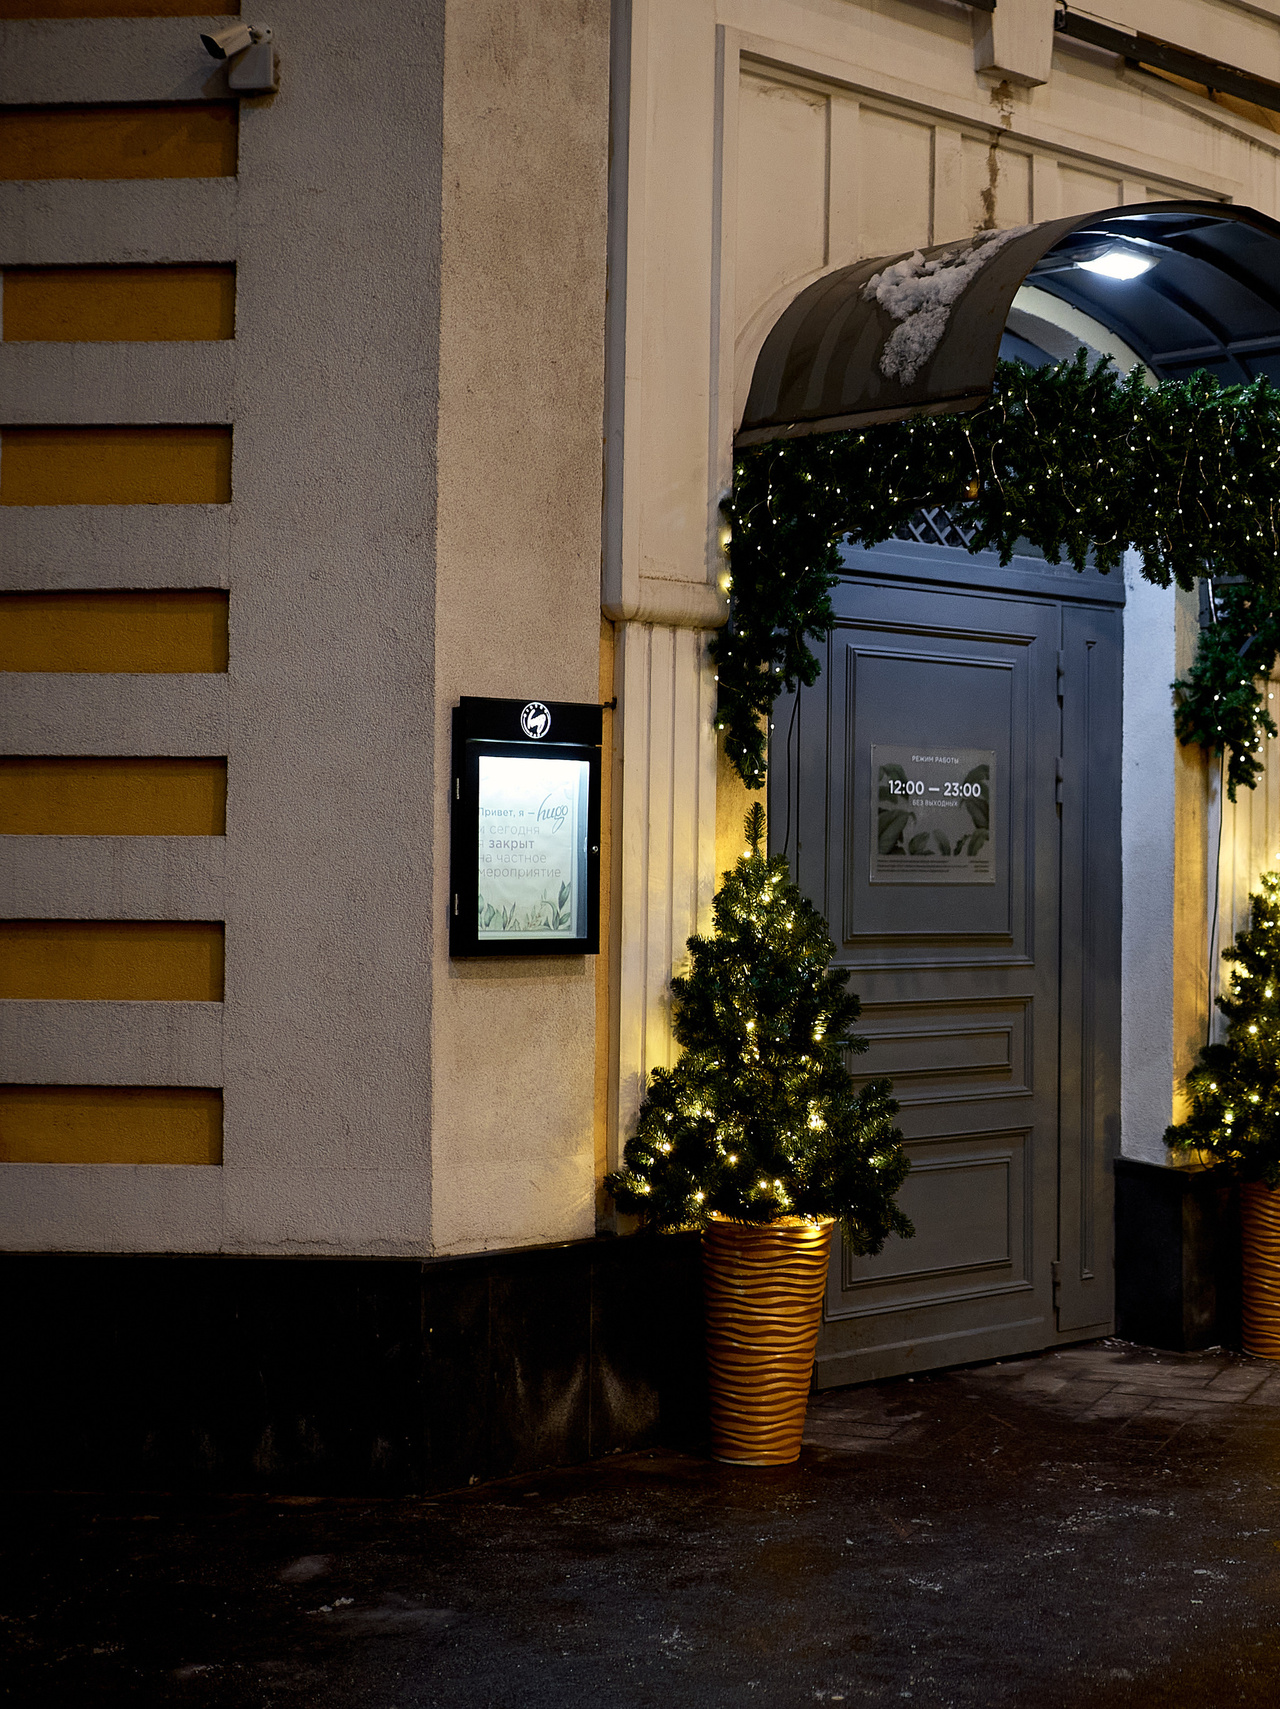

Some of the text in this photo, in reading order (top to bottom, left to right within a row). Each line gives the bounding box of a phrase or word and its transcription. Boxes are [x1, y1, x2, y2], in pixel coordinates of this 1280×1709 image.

[911, 755, 959, 764] РЕЖИМ РАБОТЫ
[888, 779, 925, 795] 12:00
[943, 781, 981, 798] 23:00
[924, 799, 958, 807] ВЫХОДНЫХ
[489, 826, 540, 836] сегодня
[488, 840, 535, 851] закрыт
[496, 854, 547, 863] частное
